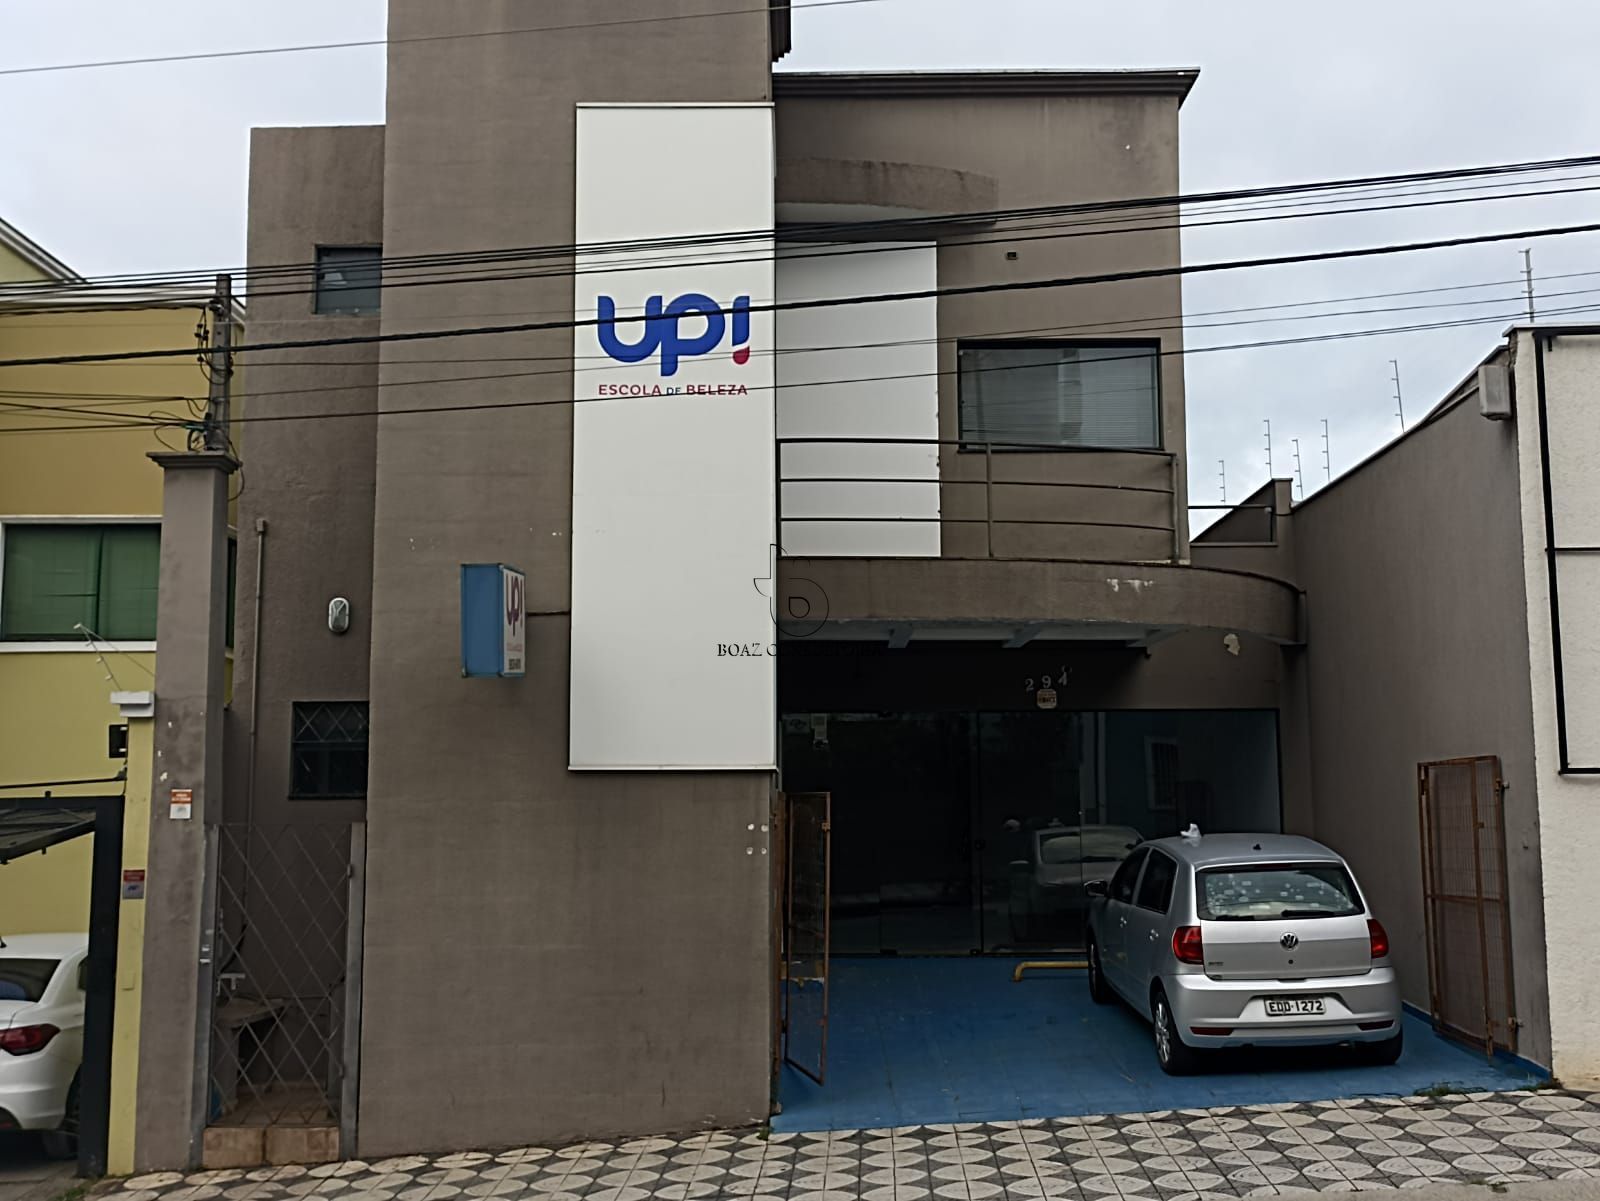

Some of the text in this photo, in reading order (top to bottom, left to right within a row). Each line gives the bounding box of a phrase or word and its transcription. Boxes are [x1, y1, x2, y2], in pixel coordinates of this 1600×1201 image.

[599, 384, 748, 396] ESCOLA DE BELEZA
